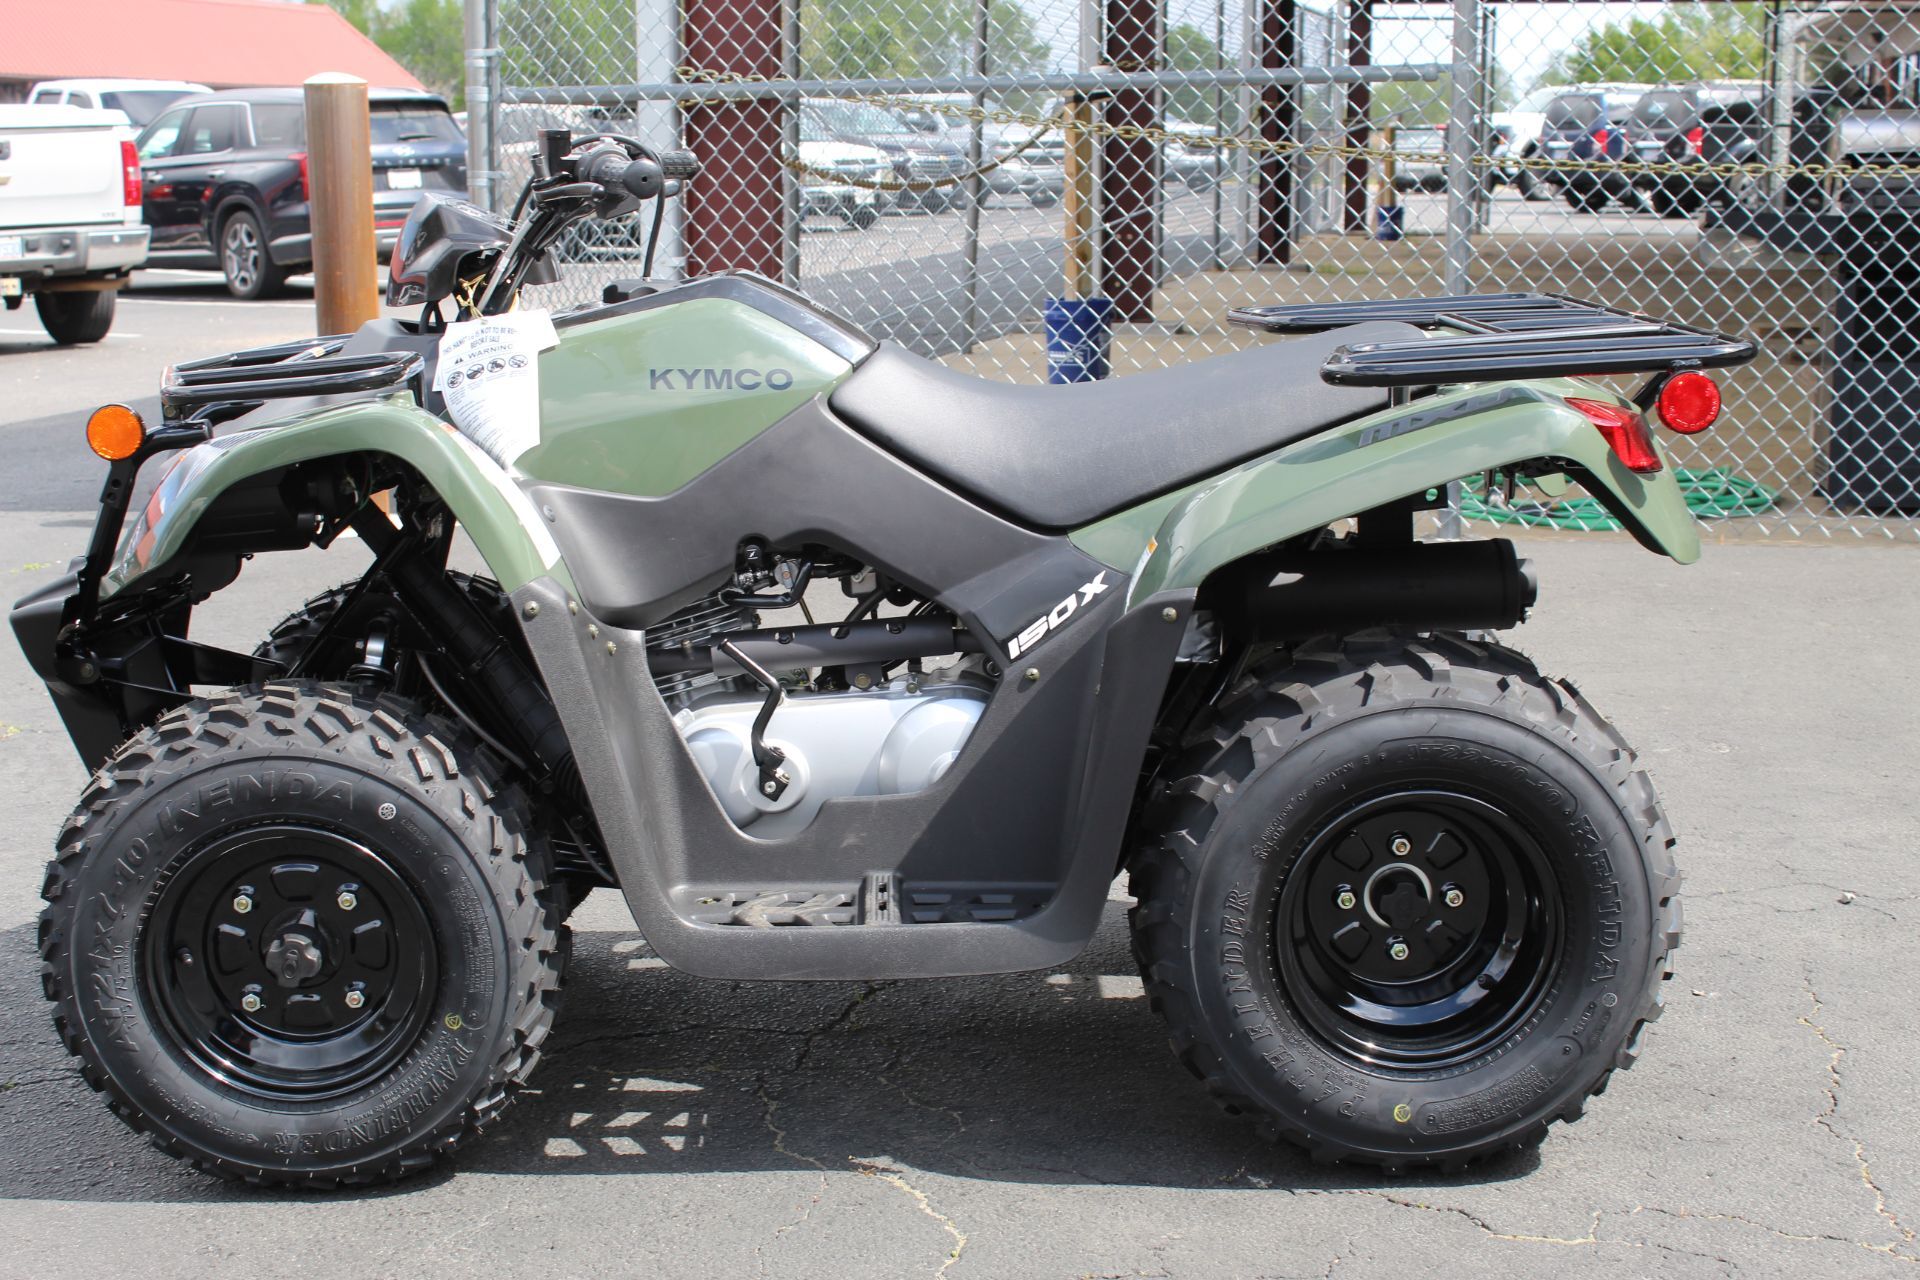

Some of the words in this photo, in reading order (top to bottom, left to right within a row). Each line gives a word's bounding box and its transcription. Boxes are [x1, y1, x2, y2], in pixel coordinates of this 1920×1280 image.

[467, 343, 514, 359] WARNING
[649, 368, 793, 391] KYMCO
[161, 772, 353, 834] KENDA
[1568, 816, 1622, 983] KENDA
[1220, 888, 1366, 1118] PATHFINDER
[272, 1036, 475, 1156] PATHFINDER
